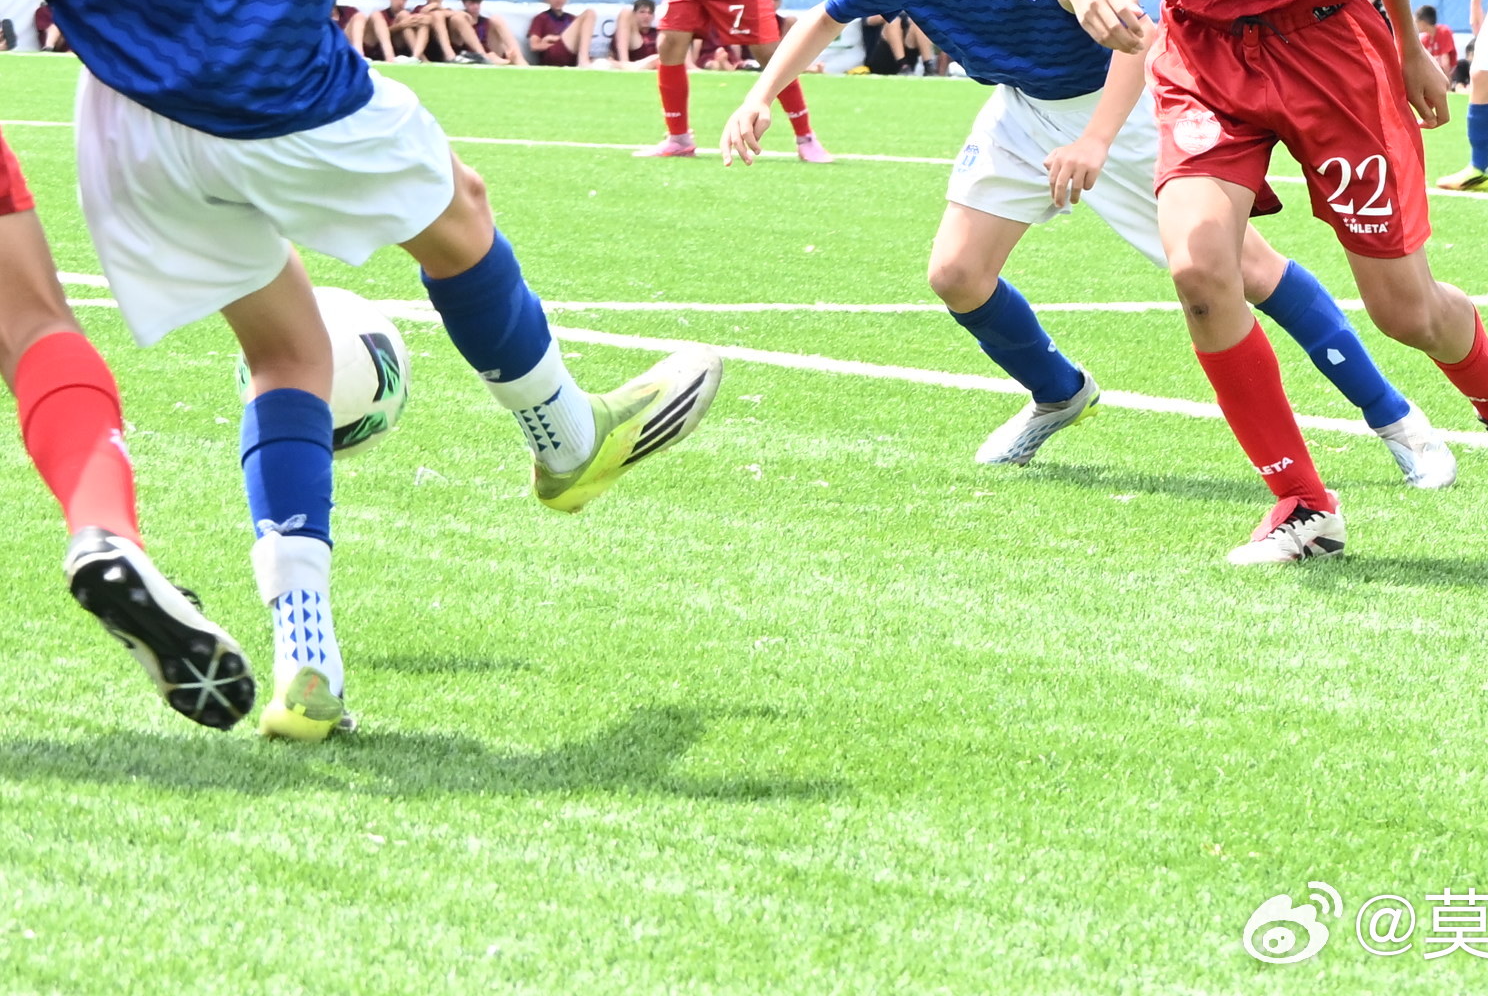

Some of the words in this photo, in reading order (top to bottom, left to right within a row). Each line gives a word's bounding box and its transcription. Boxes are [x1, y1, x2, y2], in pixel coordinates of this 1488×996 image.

[728, 4, 745, 28] 7
[1316, 154, 1393, 216] 22
[1346, 222, 1389, 234] HLETA
